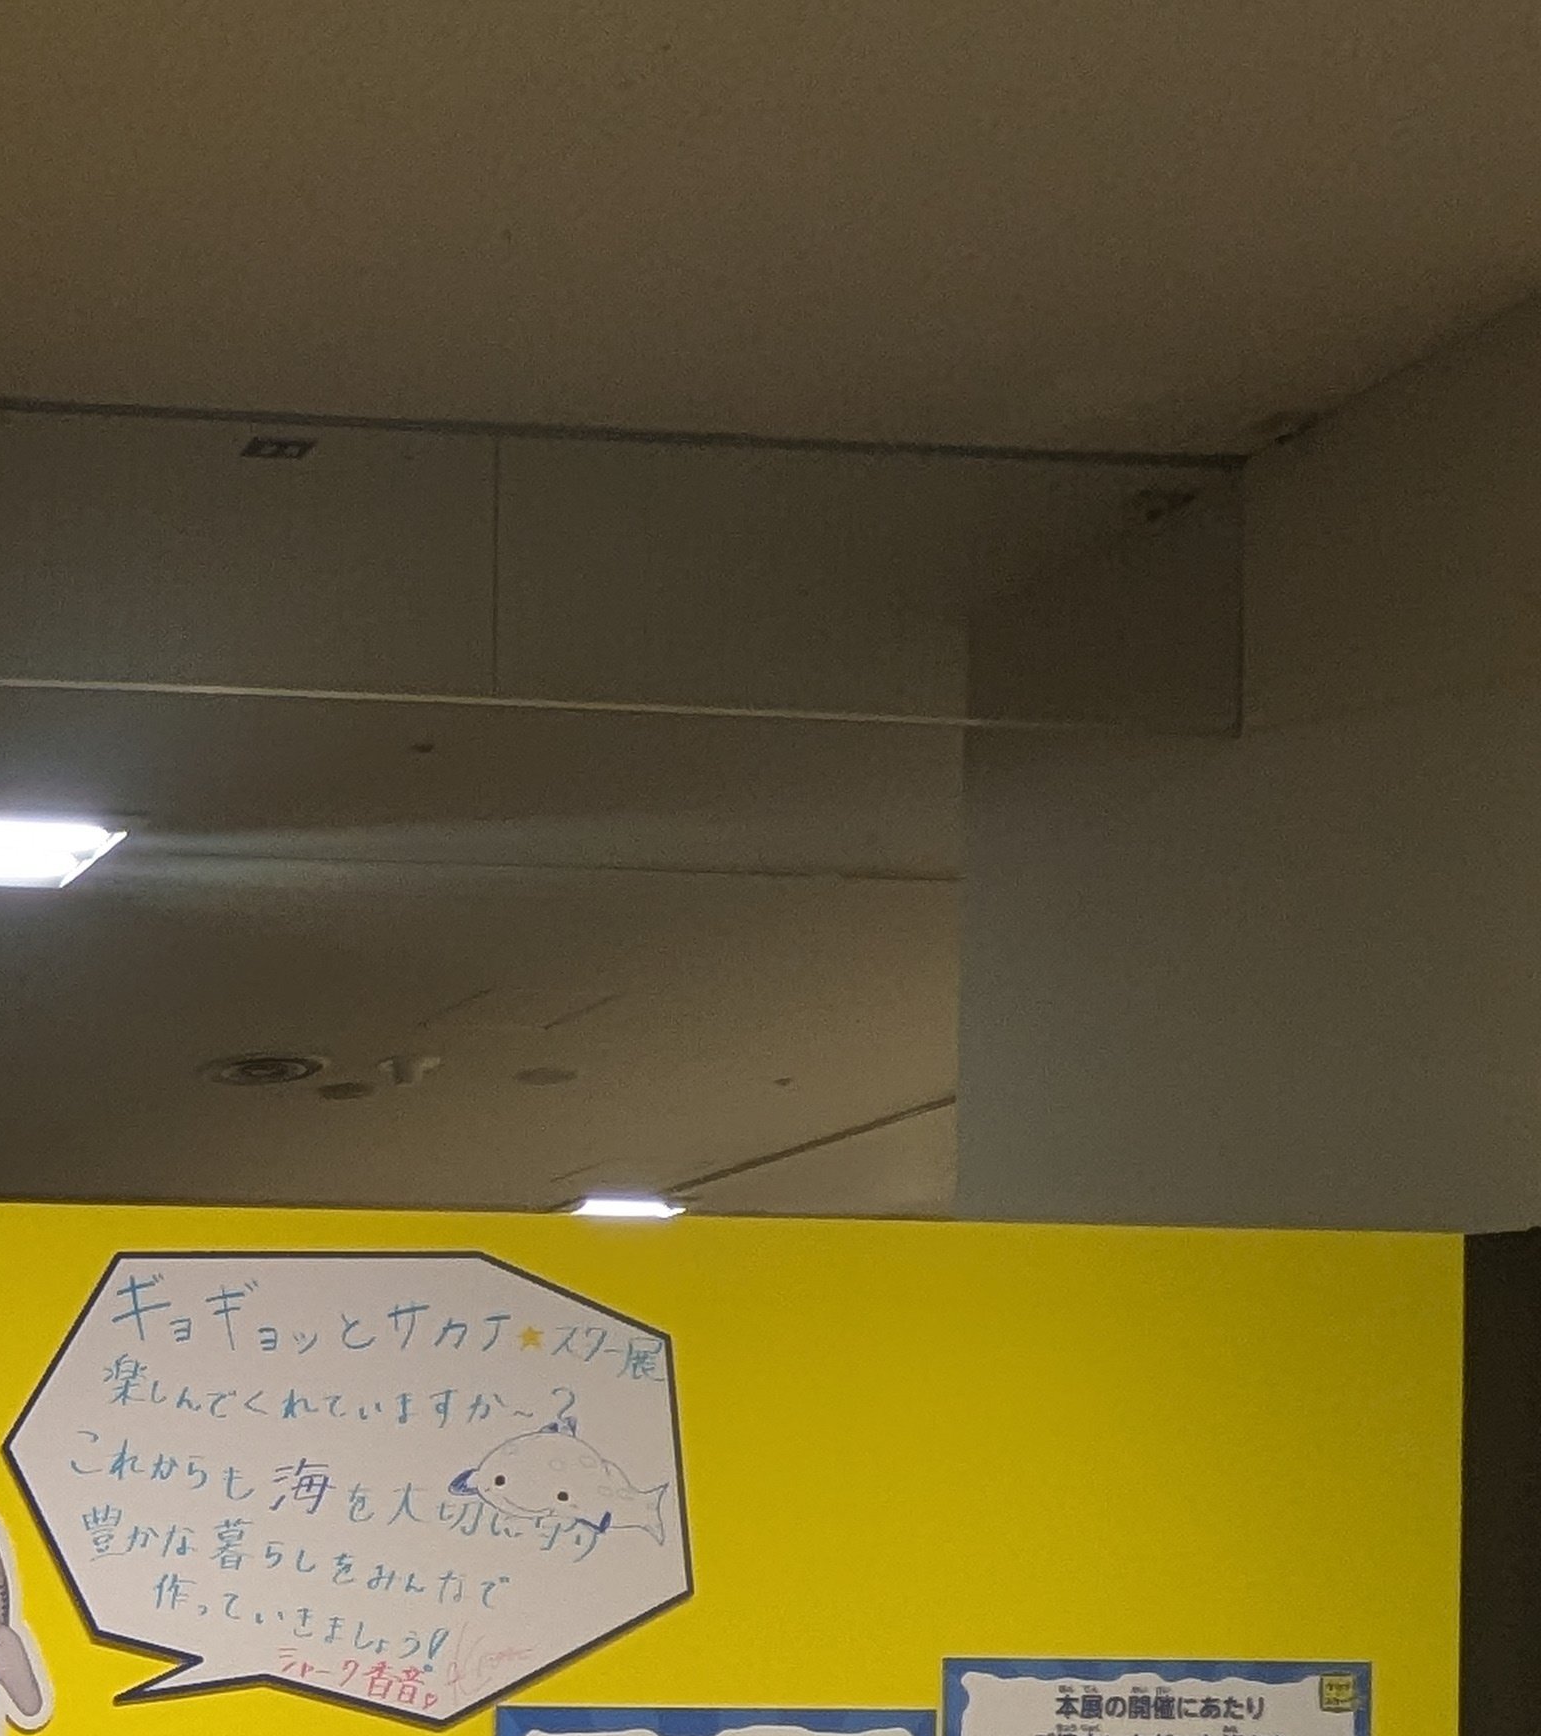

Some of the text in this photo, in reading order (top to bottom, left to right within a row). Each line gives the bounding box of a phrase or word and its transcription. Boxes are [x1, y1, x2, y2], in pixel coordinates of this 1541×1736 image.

[1055, 1694, 1265, 1720] 本展の開催にあたり
